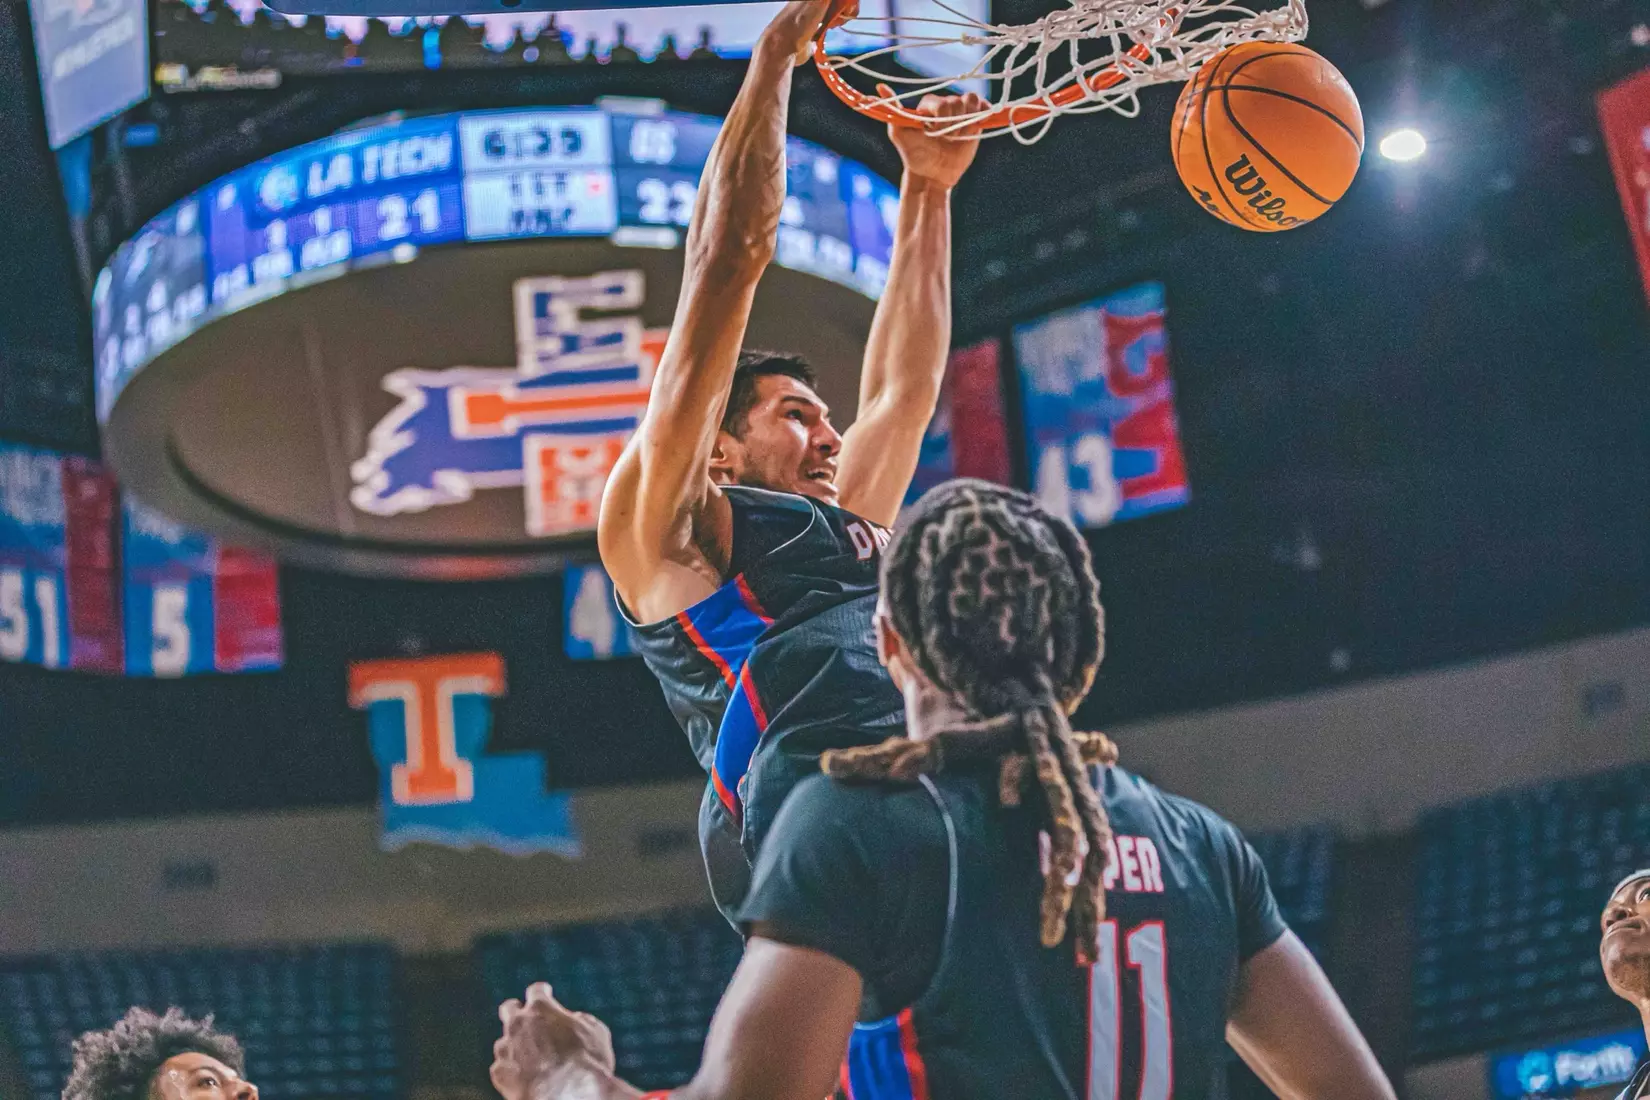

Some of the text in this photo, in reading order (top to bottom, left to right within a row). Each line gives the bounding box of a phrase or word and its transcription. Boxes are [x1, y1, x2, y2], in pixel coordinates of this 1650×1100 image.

[151, 583, 191, 679] 5
[570, 569, 614, 657] 4
[1074, 918, 1173, 1100] 11
